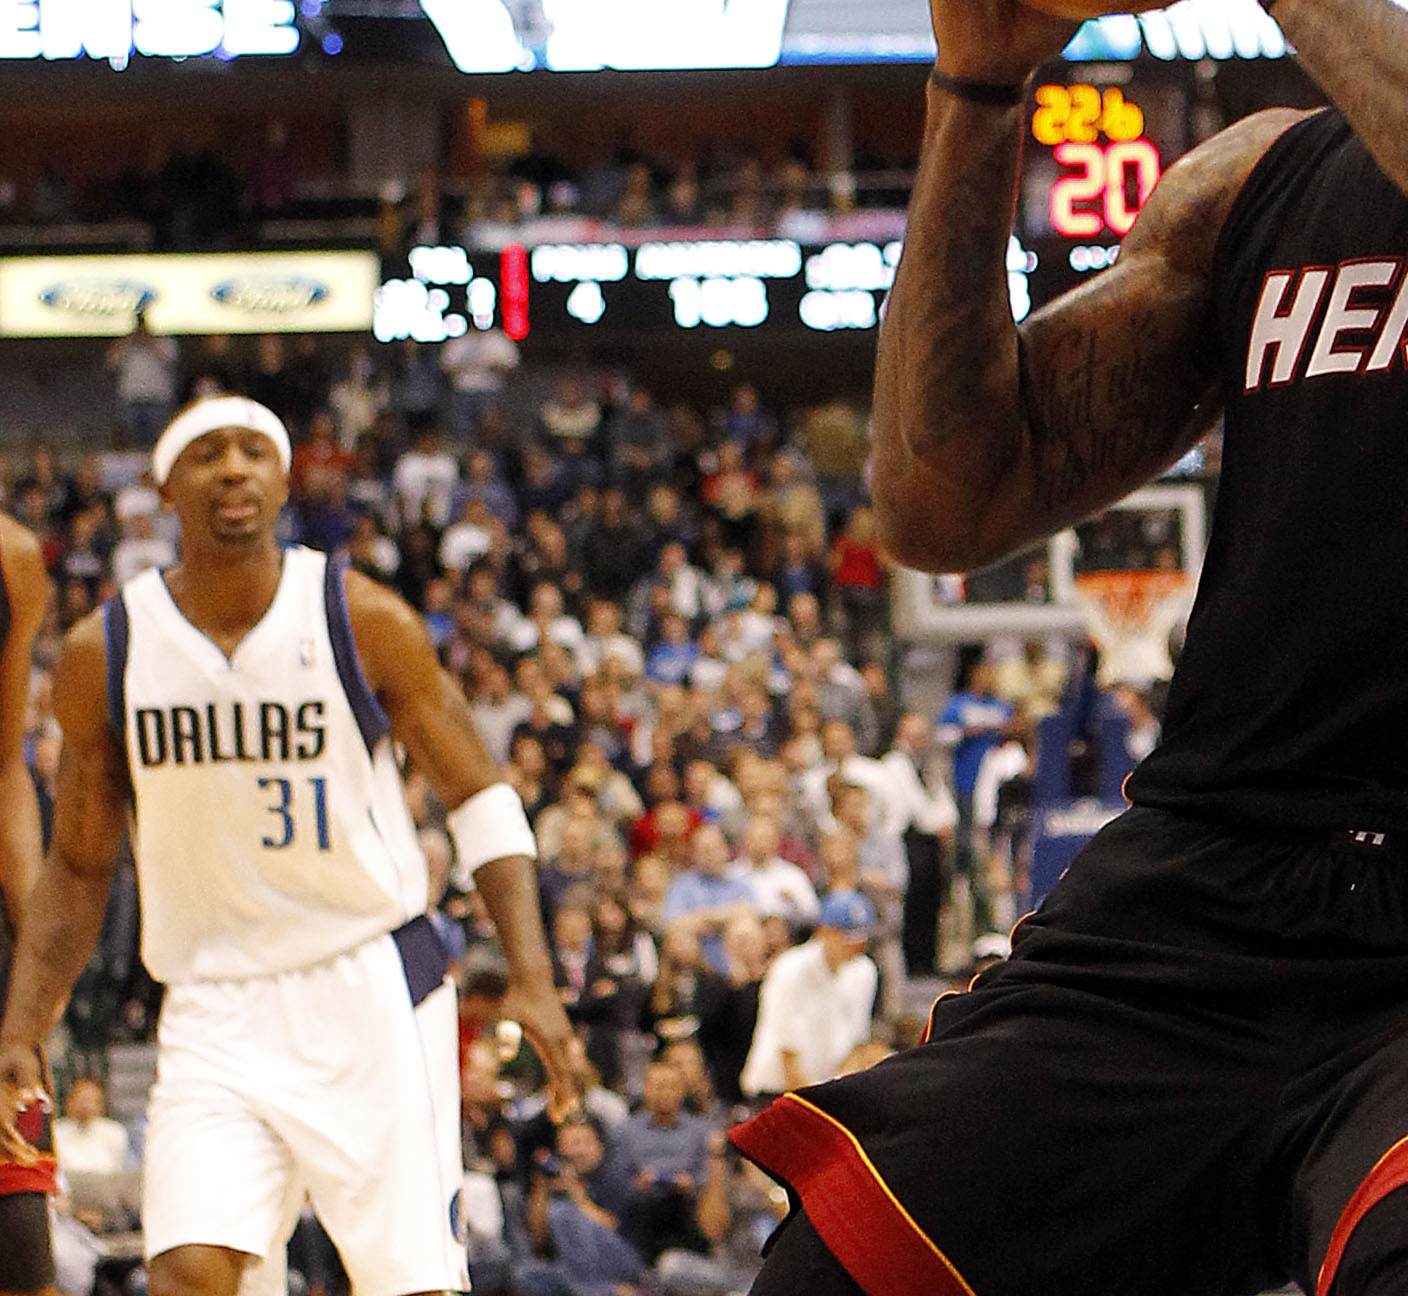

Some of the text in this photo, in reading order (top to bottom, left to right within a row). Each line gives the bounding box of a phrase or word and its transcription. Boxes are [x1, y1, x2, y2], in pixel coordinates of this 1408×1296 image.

[1050, 137, 1160, 238] 20
[135, 700, 327, 768] DALLAS
[257, 777, 331, 851] 31
